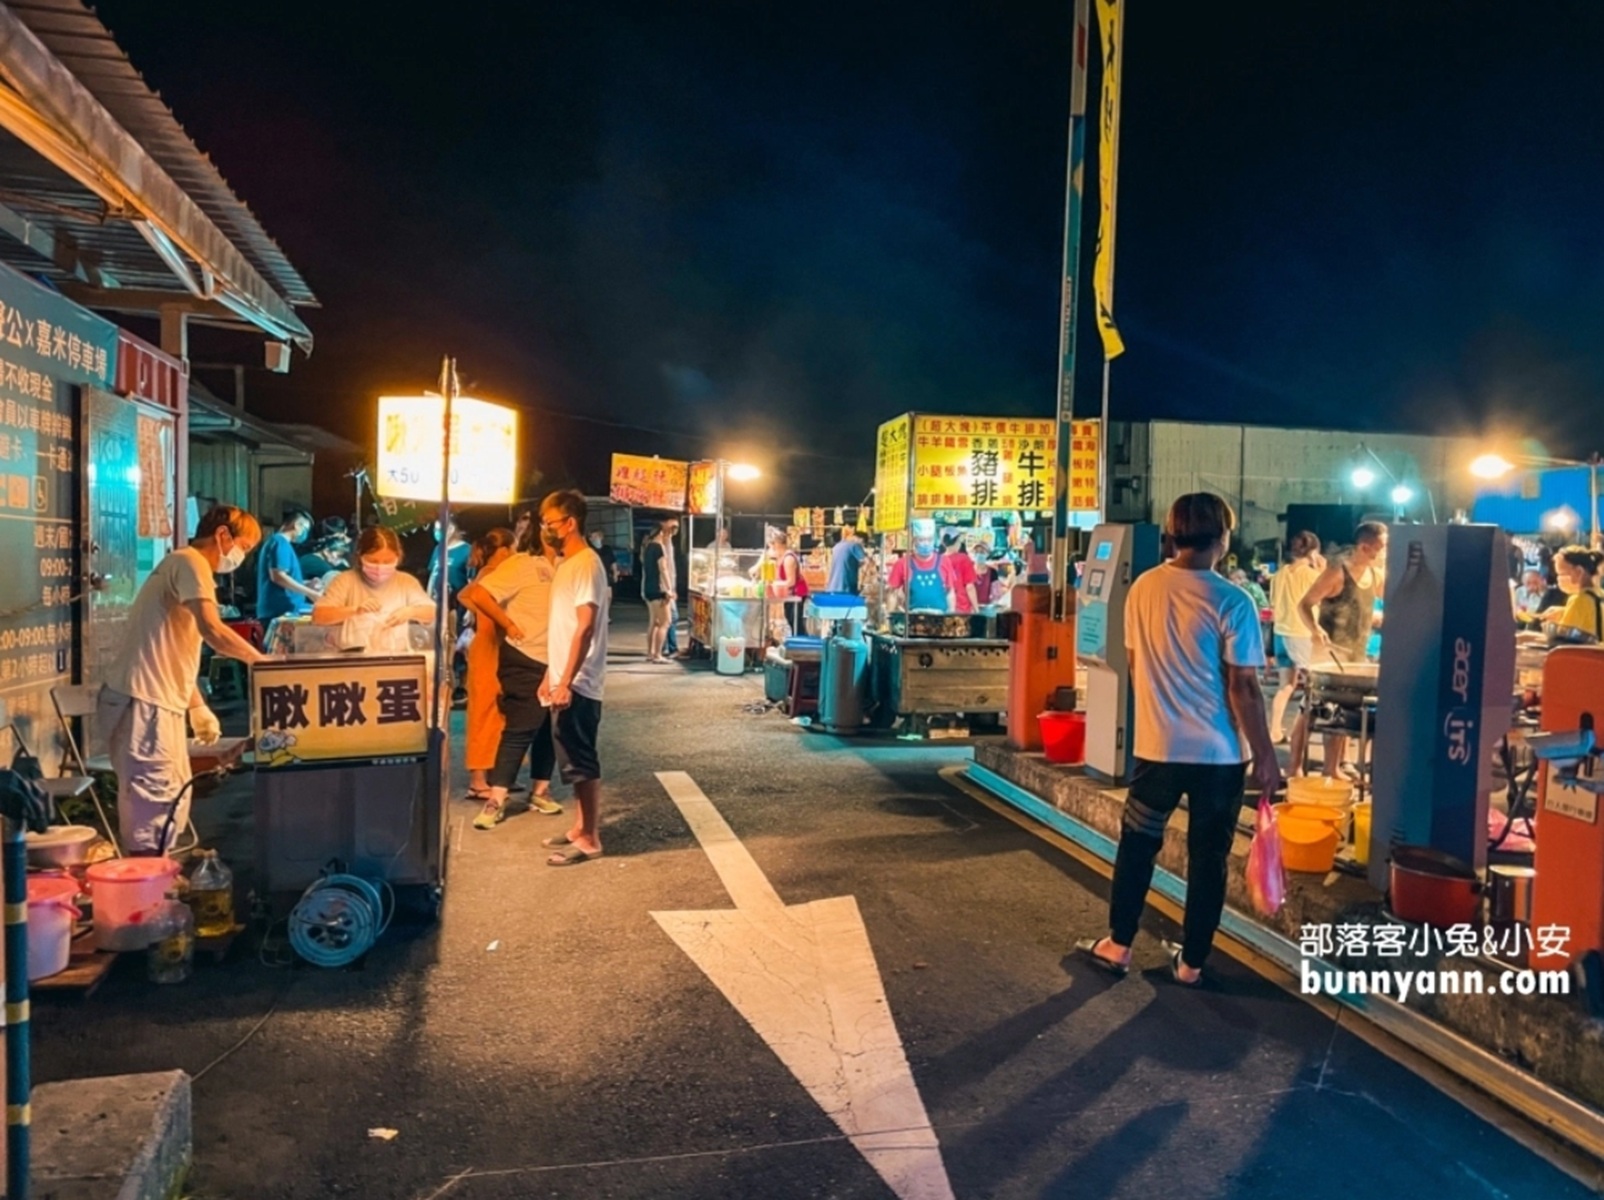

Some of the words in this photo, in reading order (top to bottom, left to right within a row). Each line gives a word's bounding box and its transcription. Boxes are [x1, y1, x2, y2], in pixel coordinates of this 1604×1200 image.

[971, 450, 999, 506] 豬排
[1017, 450, 1045, 507] 牛排
[1453, 637, 1472, 703] acer
